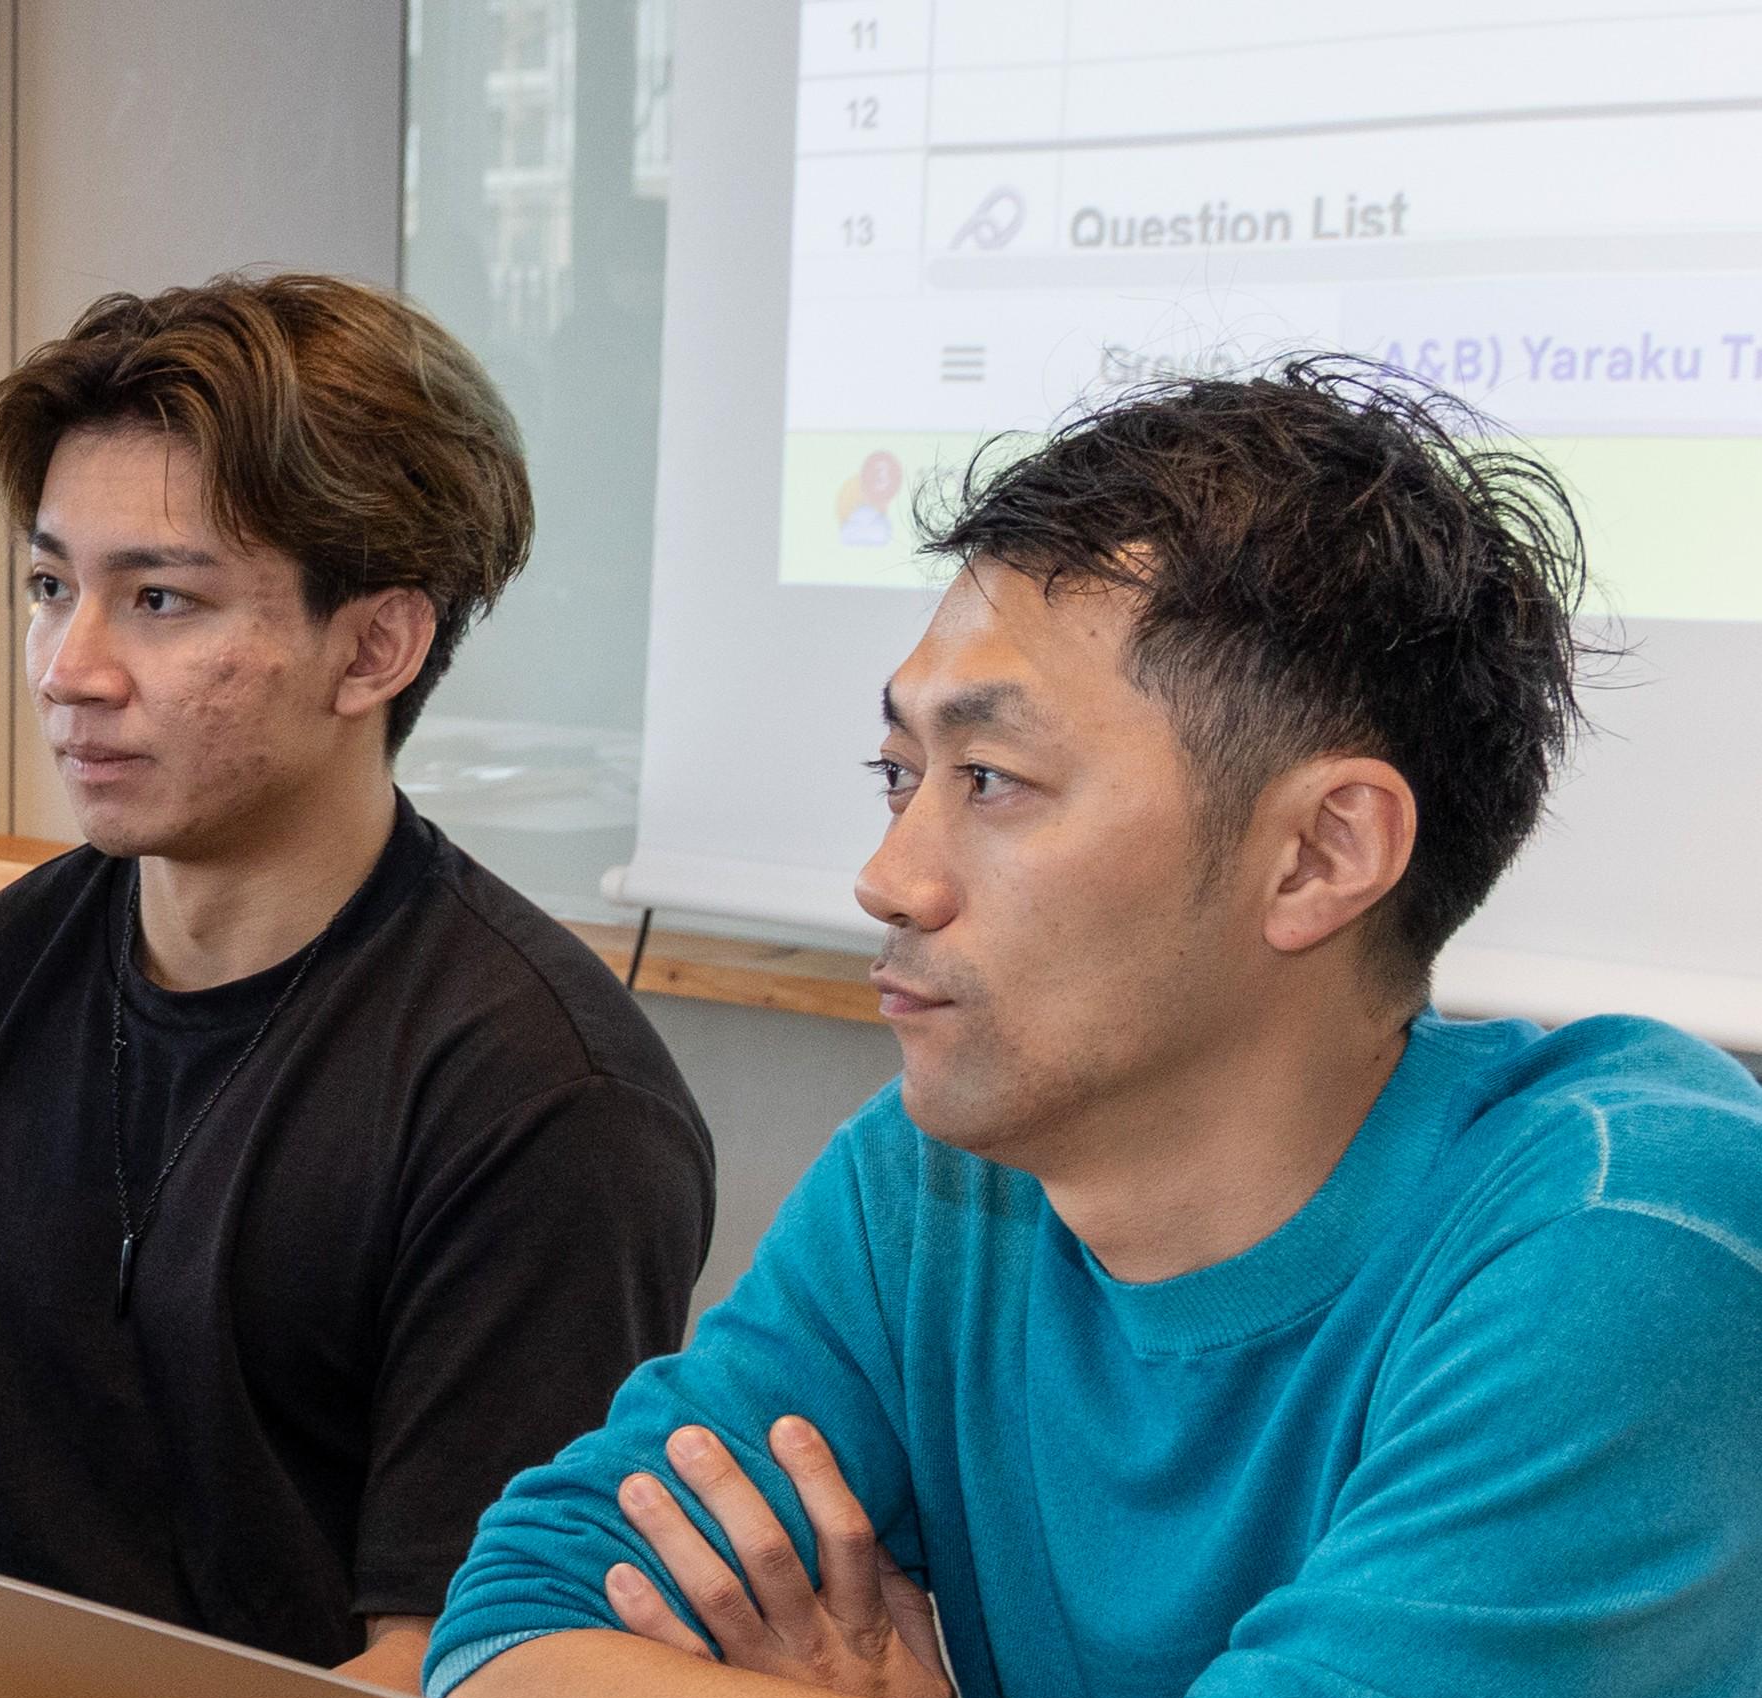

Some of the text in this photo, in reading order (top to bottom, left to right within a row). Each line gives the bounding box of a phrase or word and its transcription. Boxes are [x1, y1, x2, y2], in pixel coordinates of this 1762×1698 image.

[849, 17, 879, 51] 11
[844, 95, 880, 130] 12
[841, 213, 875, 248] 13
[1070, 191, 1410, 250] Question List
[1521, 333, 1703, 383] Yaraku
